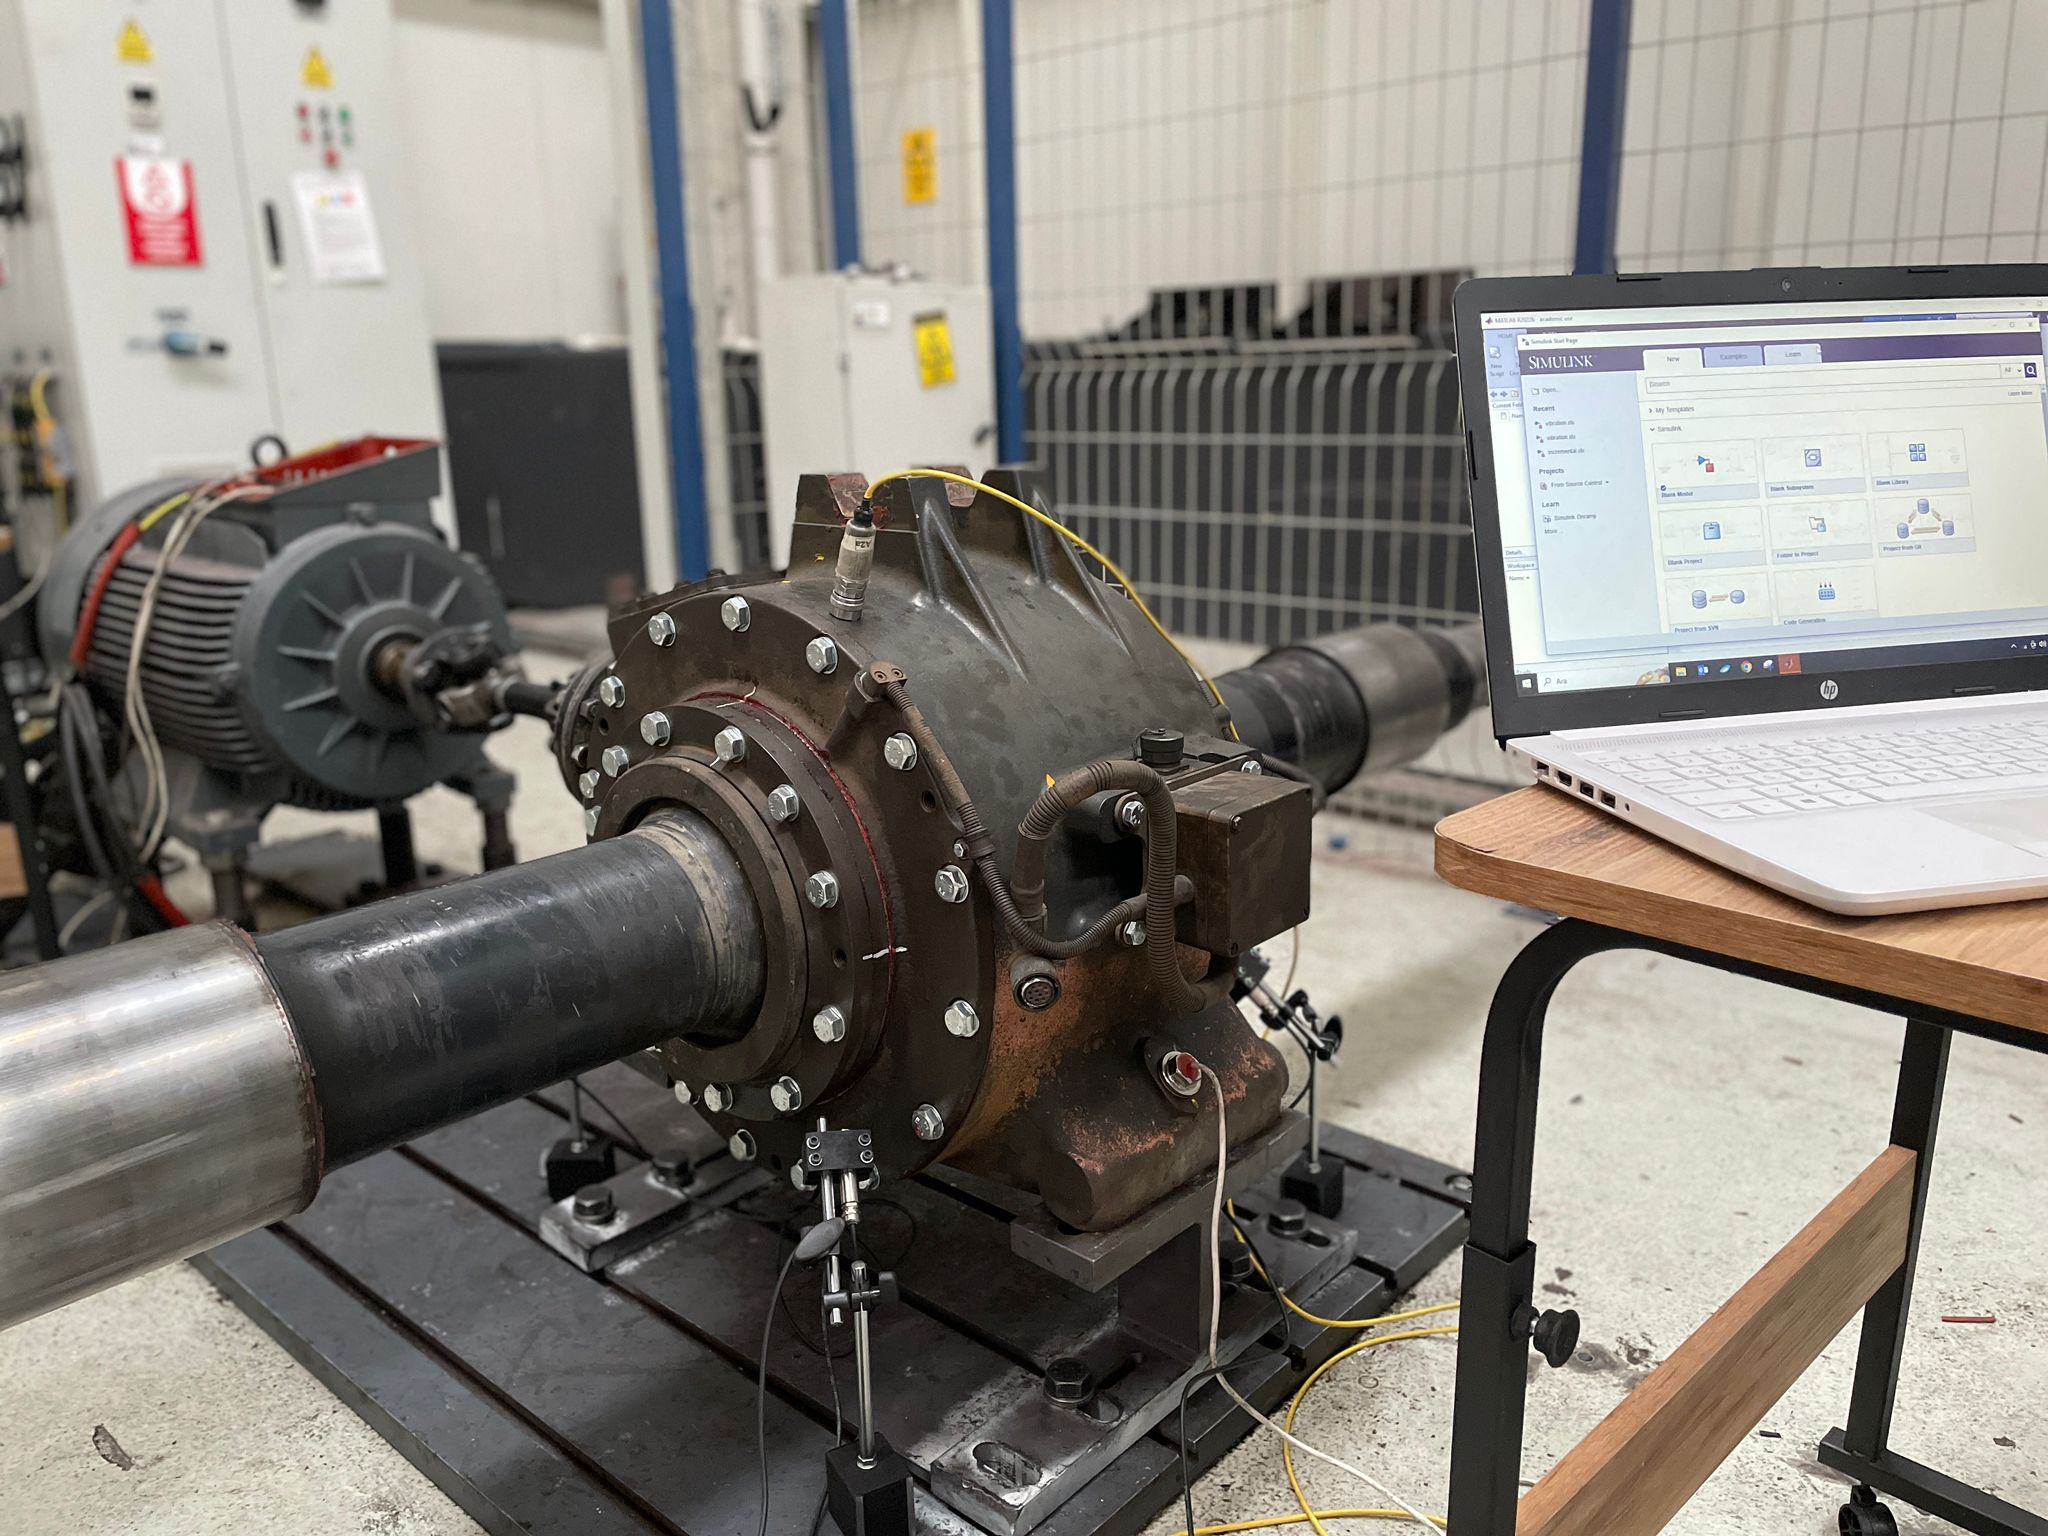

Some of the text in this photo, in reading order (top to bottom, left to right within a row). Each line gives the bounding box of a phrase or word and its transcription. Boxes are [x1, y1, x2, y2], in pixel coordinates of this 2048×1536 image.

[1720, 353, 1748, 361] Examples
[1528, 355, 1593, 370] SIMULINK
[1666, 406, 1694, 414] Templates
[1538, 468, 1564, 476] Projects
[1890, 478, 1909, 486] Library
[1800, 550, 1819, 558] Project
[1684, 558, 1703, 566] Project
[1821, 680, 1838, 699] hp
